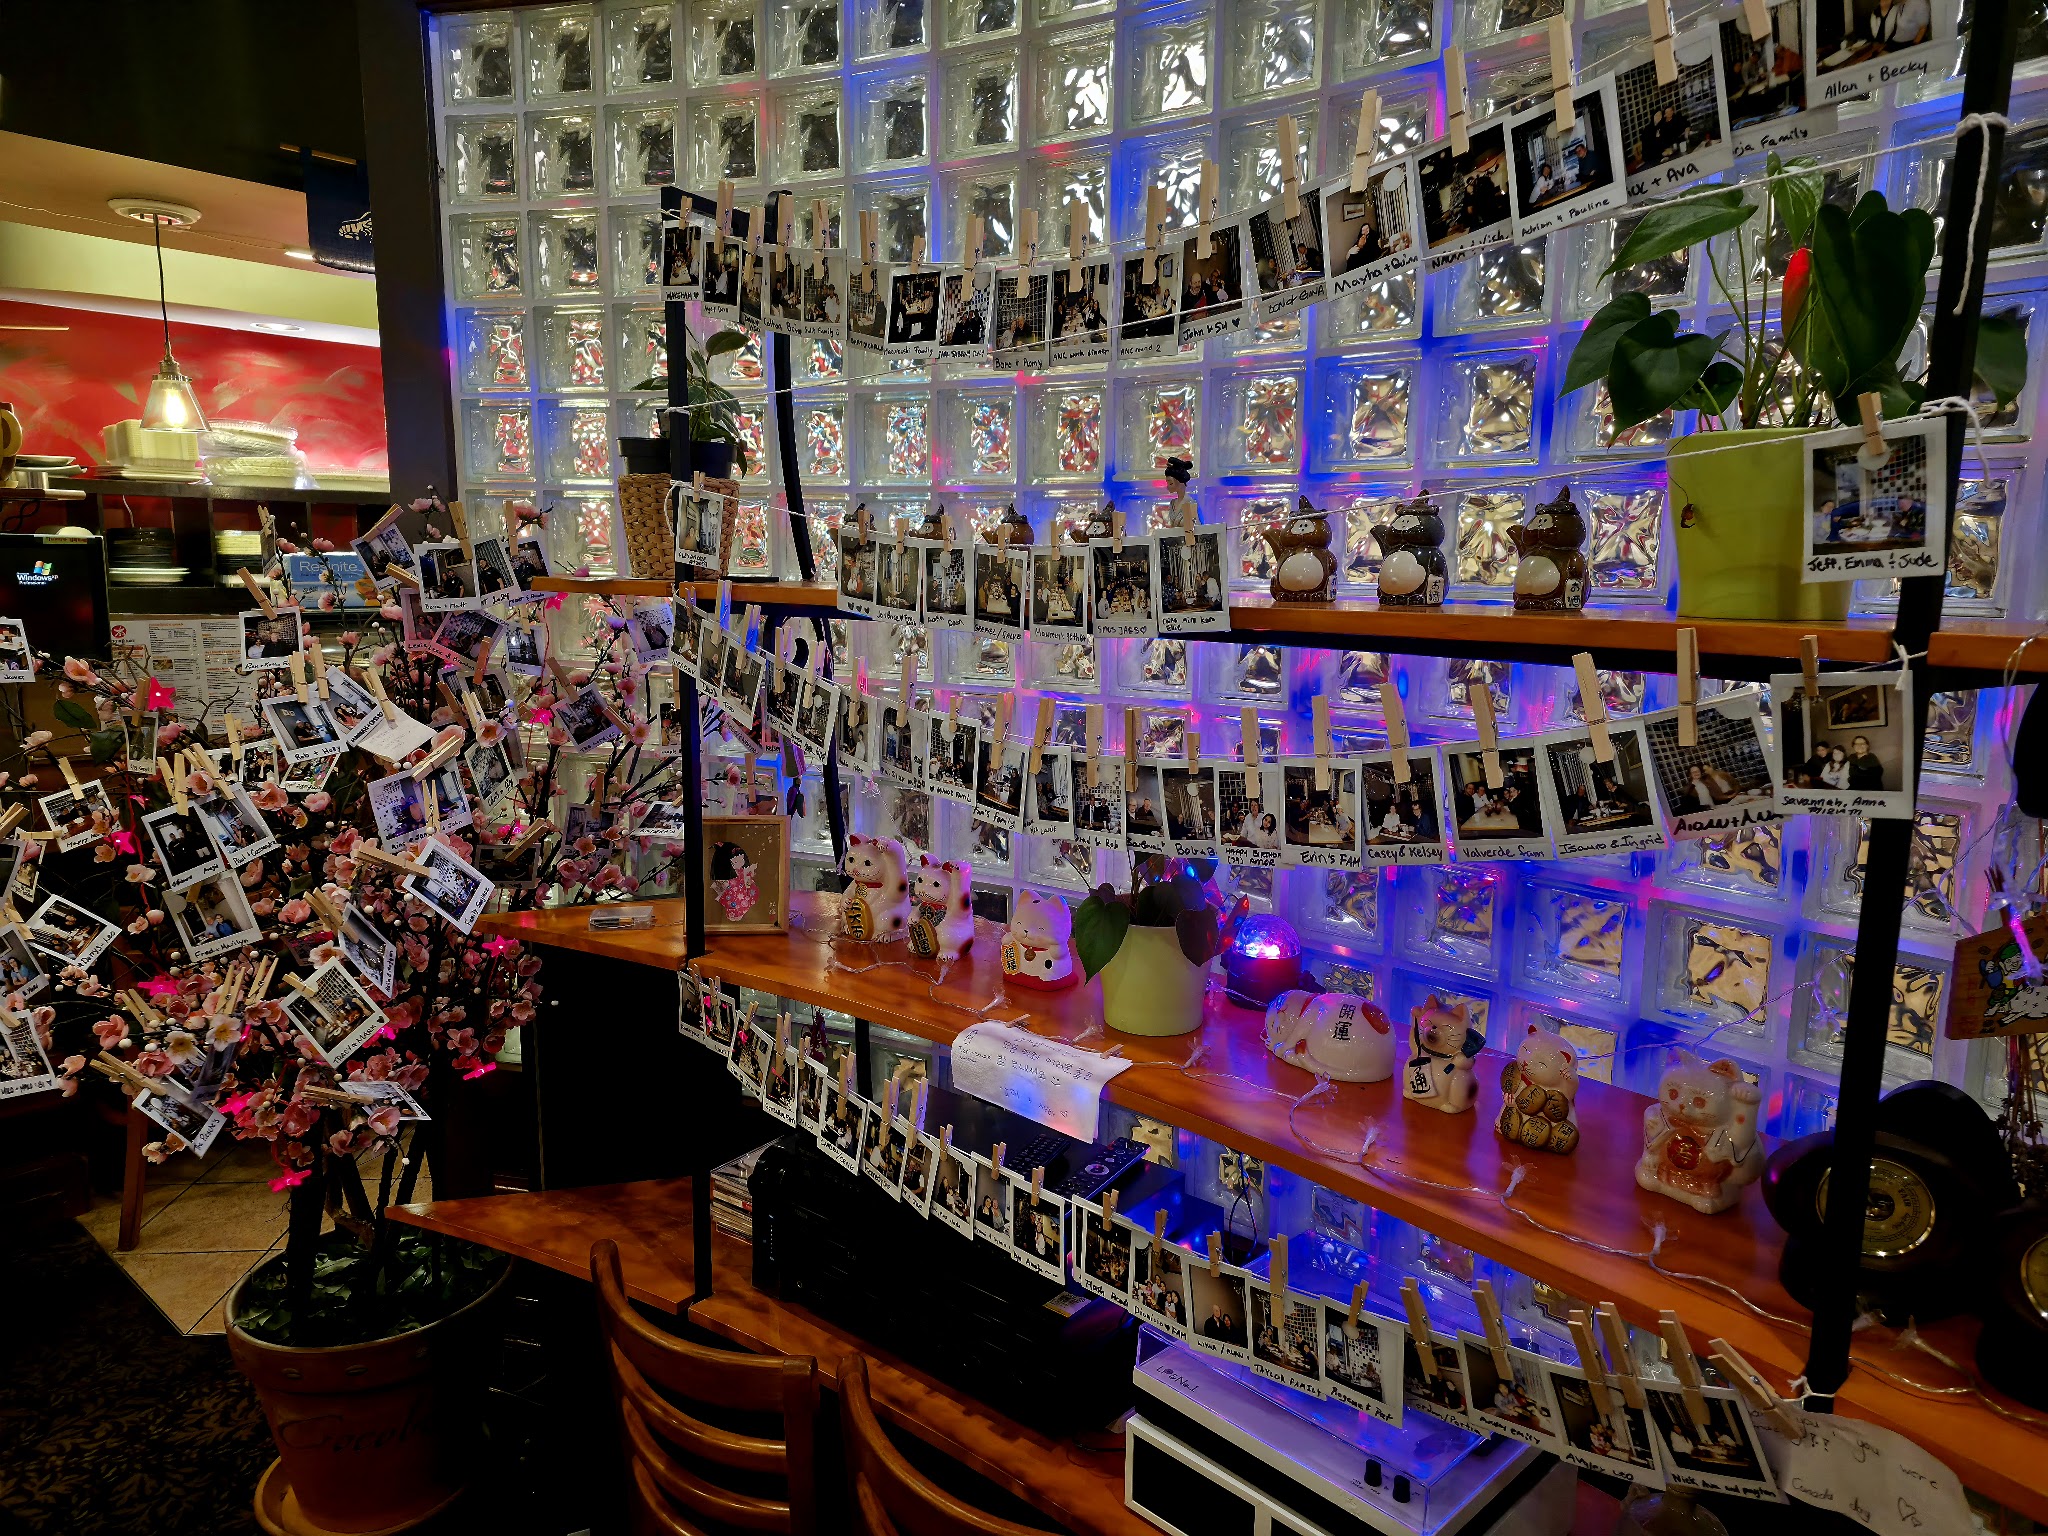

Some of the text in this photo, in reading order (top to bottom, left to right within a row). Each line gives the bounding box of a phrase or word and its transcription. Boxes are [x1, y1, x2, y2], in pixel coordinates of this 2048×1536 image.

[1824, 80, 1858, 100] Allan
[1880, 59, 1928, 82] Becky
[1760, 126, 1809, 149] Family
[1568, 197, 1611, 220] Pauline
[1182, 325, 1206, 342] John
[1155, 343, 1163, 353] 2
[1844, 556, 1885, 570] Emma
[1898, 551, 1939, 569] Jude
[16, 574, 52, 583] Windows
[1300, 850, 1336, 865] Erin's
[1409, 846, 1444, 862] Kelsey
[1462, 846, 1516, 858] Valverde
[194, 946, 215, 958] Fred
[1332, 1003, 1357, 1042] 開運
[1253, 1363, 1286, 1383] TAYLOR
[1791, 1476, 1834, 1501] Canada
